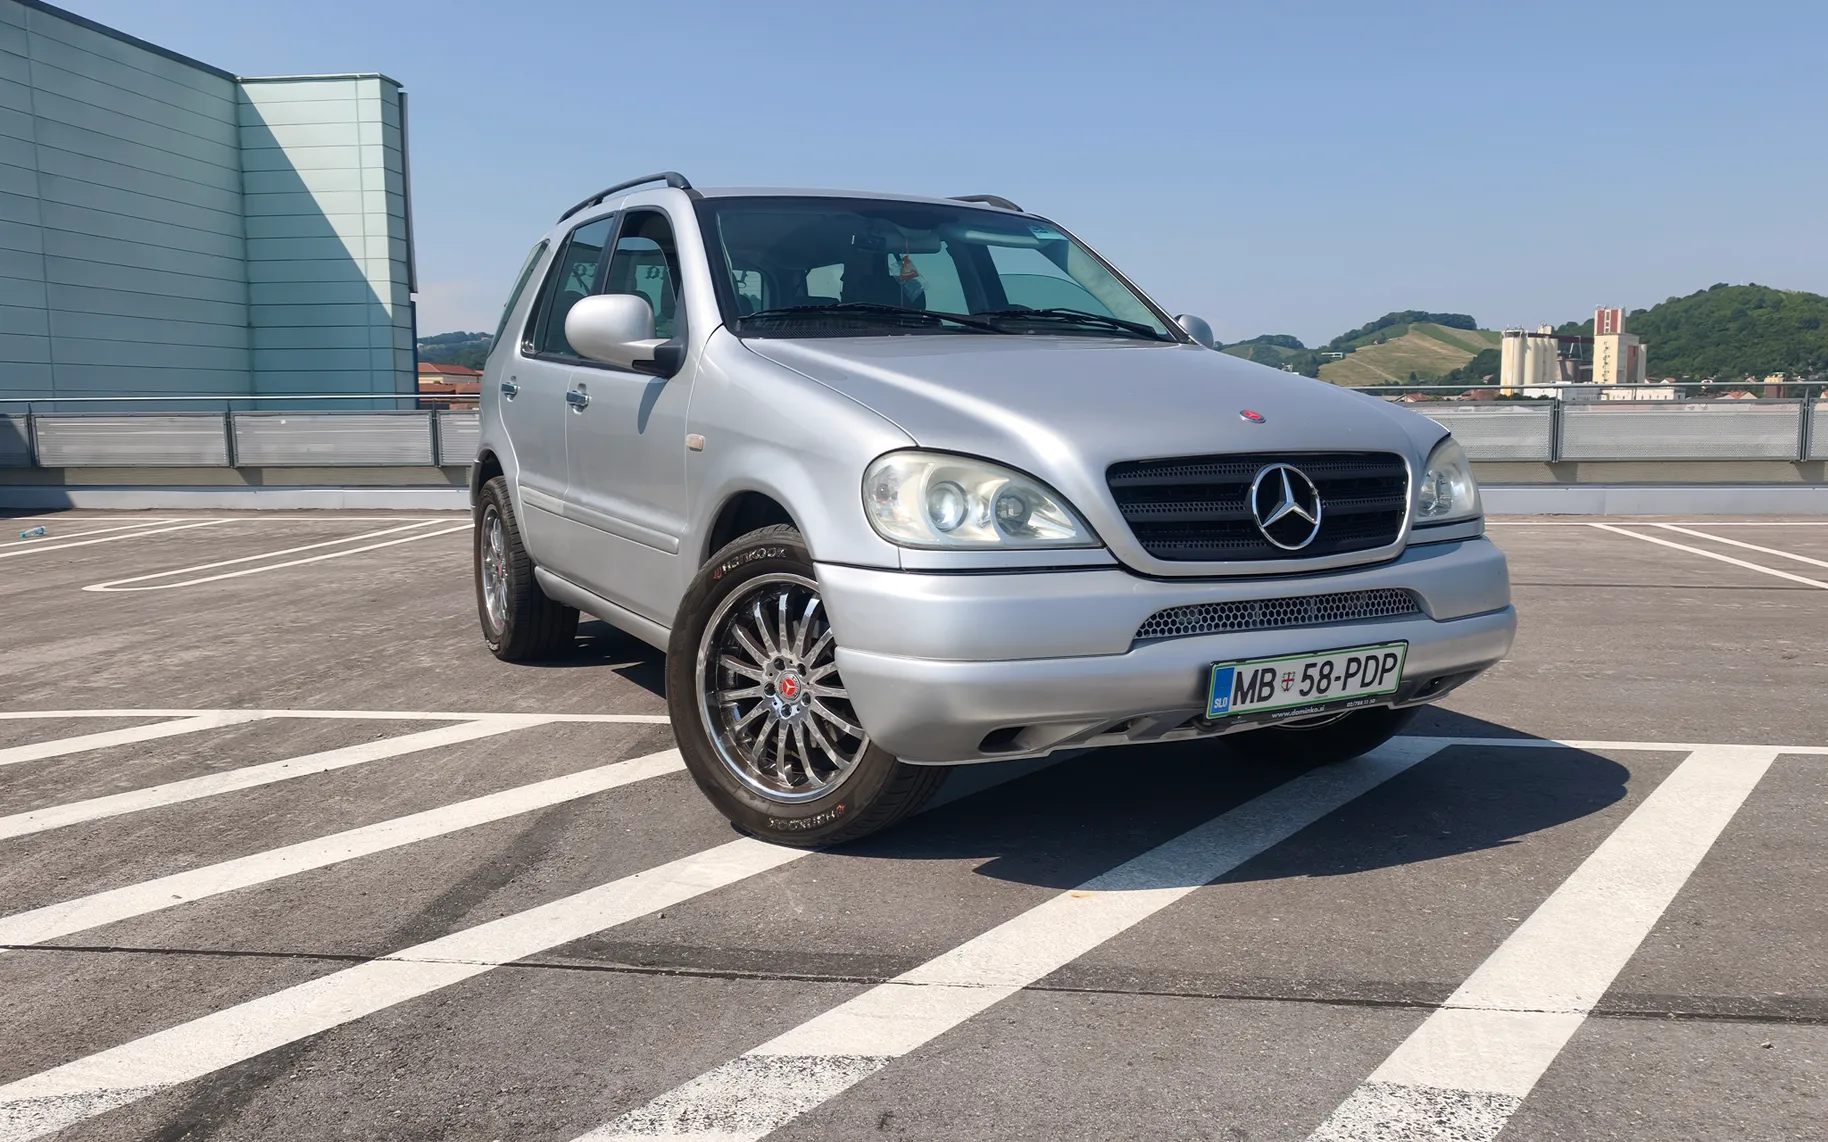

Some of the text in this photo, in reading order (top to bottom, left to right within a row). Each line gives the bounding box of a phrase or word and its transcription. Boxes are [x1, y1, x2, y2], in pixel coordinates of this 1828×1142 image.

[1232, 652, 1398, 706] MB 58-PDP
[1213, 697, 1228, 709] SLO
[1271, 705, 1326, 719] www.dominko.si
